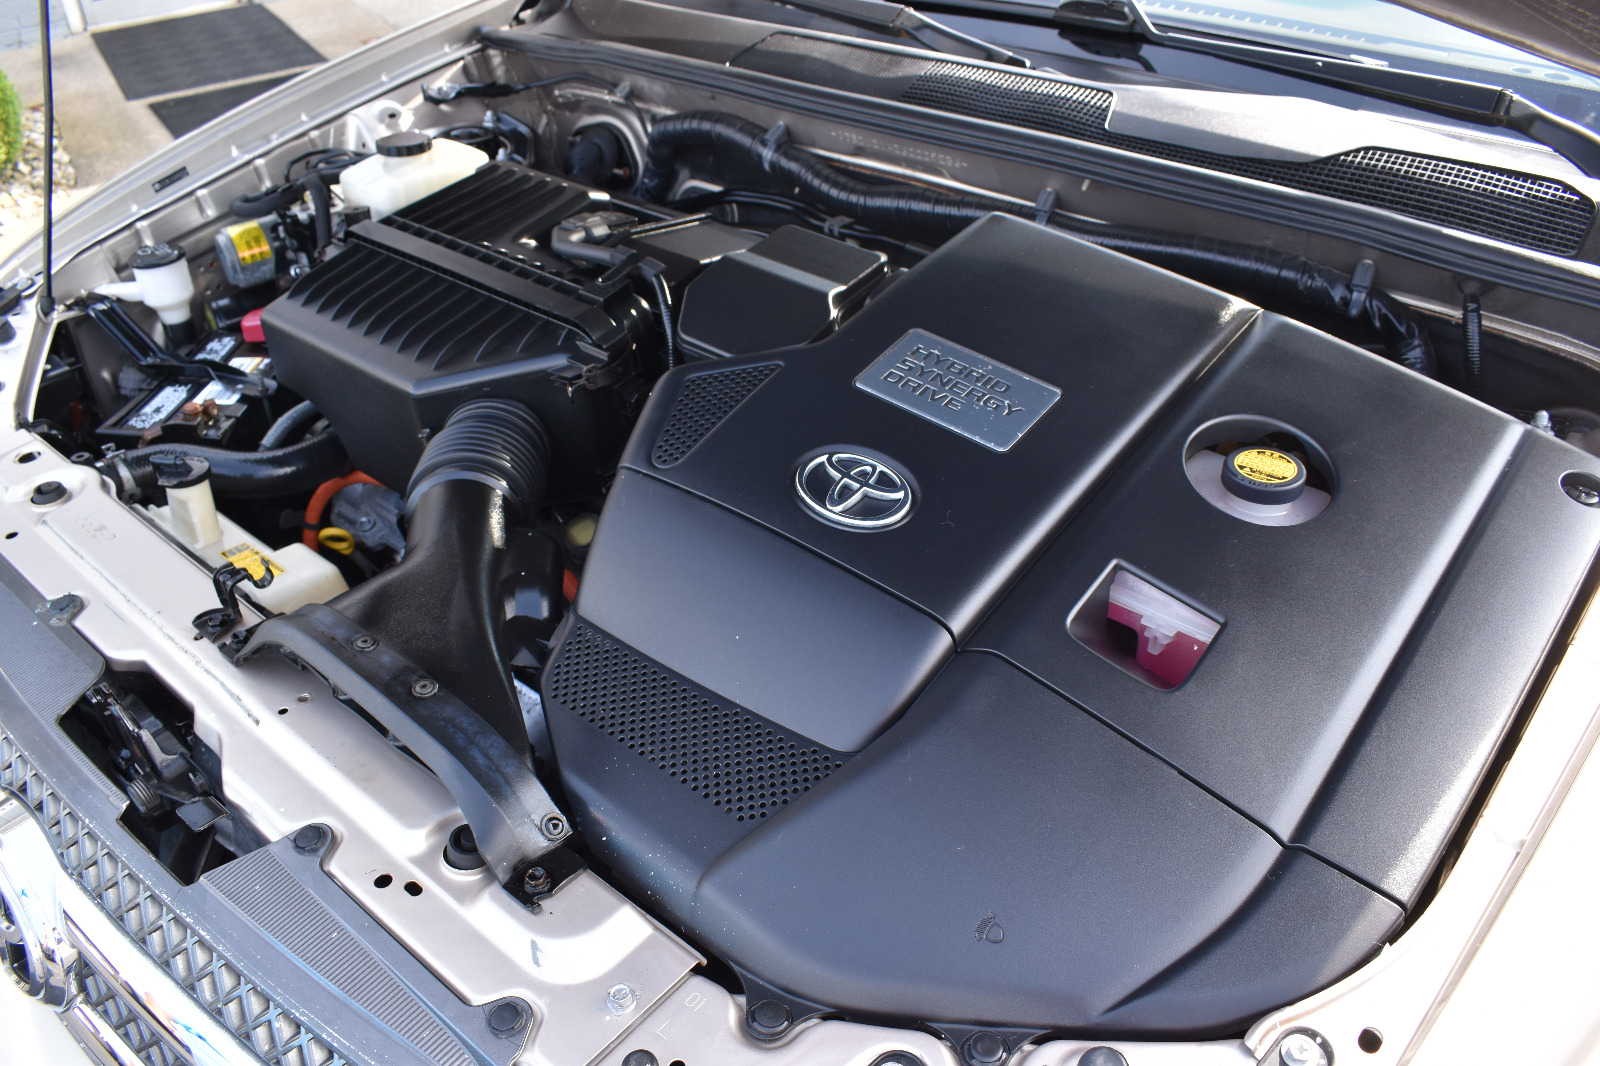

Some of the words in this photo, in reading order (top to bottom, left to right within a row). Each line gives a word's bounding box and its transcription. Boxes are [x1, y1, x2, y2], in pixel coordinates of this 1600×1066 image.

[881, 369, 965, 411] DRIVE
[896, 357, 1025, 416] SYNERGY
[908, 344, 1011, 394] HYBRID
